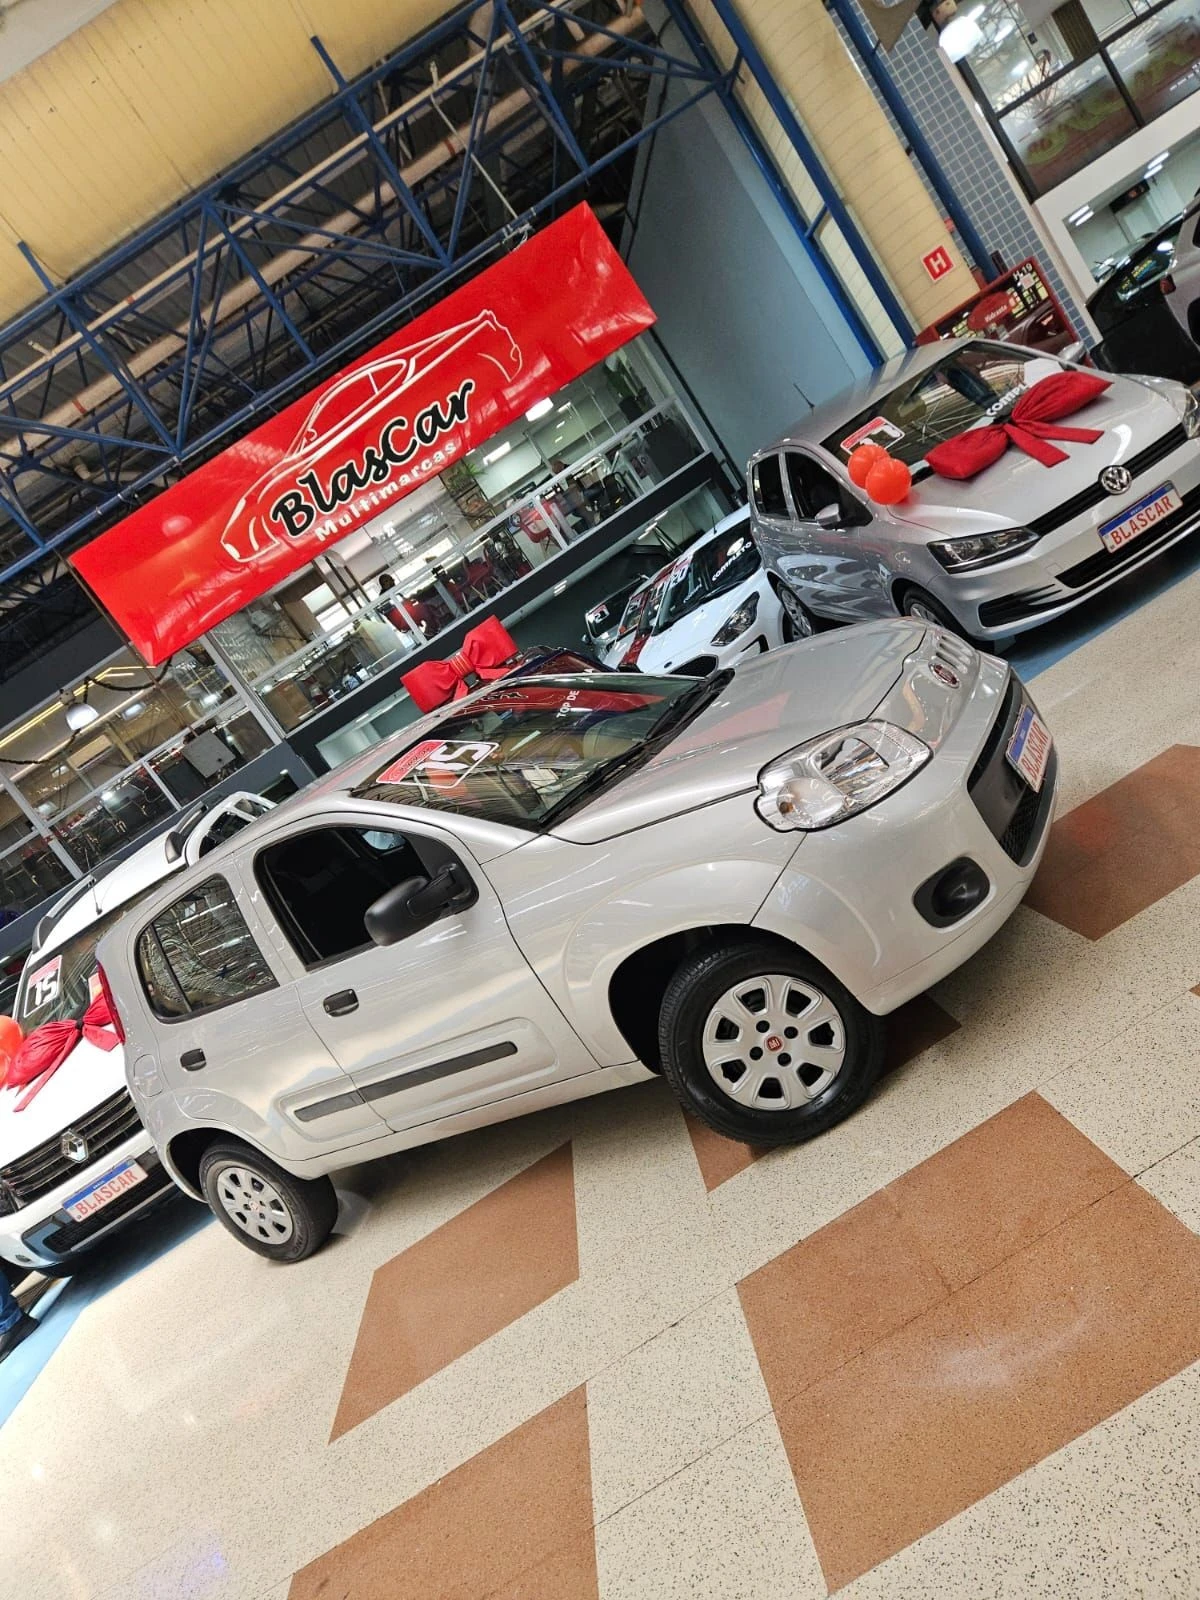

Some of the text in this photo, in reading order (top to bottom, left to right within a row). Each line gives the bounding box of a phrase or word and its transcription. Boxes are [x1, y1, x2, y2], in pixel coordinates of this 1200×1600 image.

[270, 378, 476, 538] BlasCar
[314, 439, 458, 542] Multimarcas
[1110, 495, 1174, 545] BLASCAR
[556, 690, 580, 718] TOP DE
[414, 742, 494, 772] 15
[1021, 720, 1049, 782] BLASCAR
[34, 968, 58, 1006] 15
[74, 1169, 138, 1216] BLASCAR
